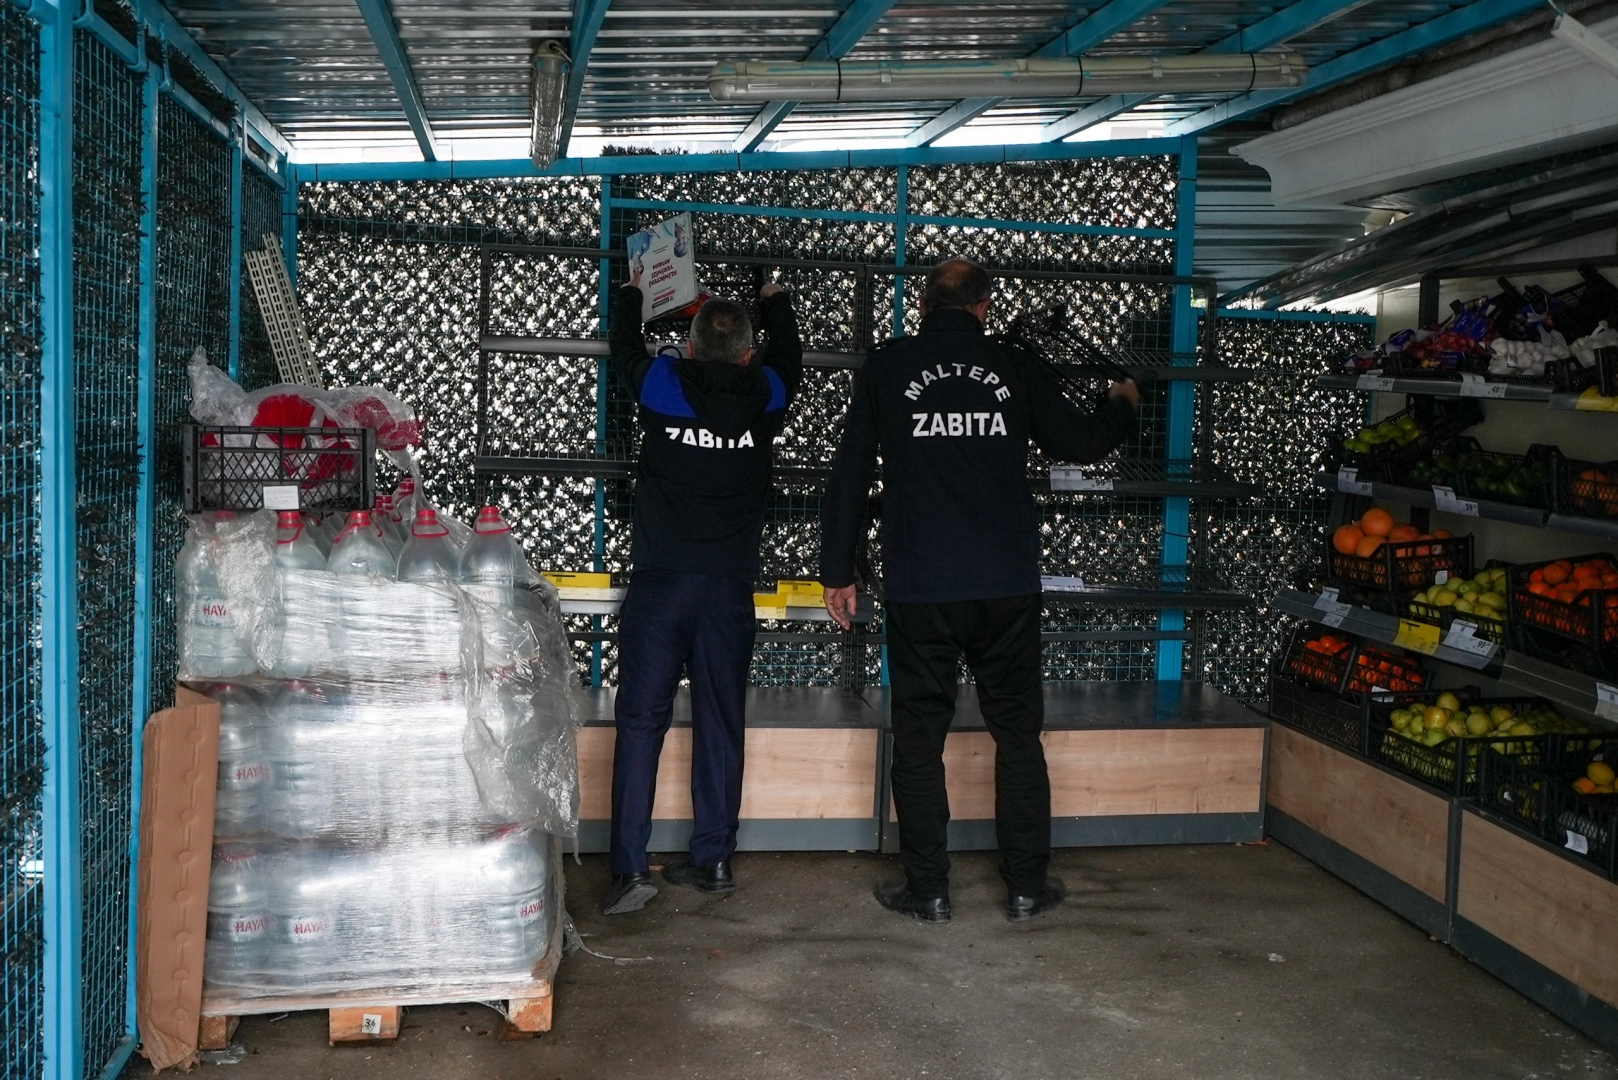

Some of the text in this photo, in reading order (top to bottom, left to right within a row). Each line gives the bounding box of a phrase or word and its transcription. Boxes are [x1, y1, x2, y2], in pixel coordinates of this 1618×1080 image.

[904, 362, 1011, 403] MALTEPE
[912, 411, 1007, 437] ZABITA
[236, 763, 268, 780] HAYA
